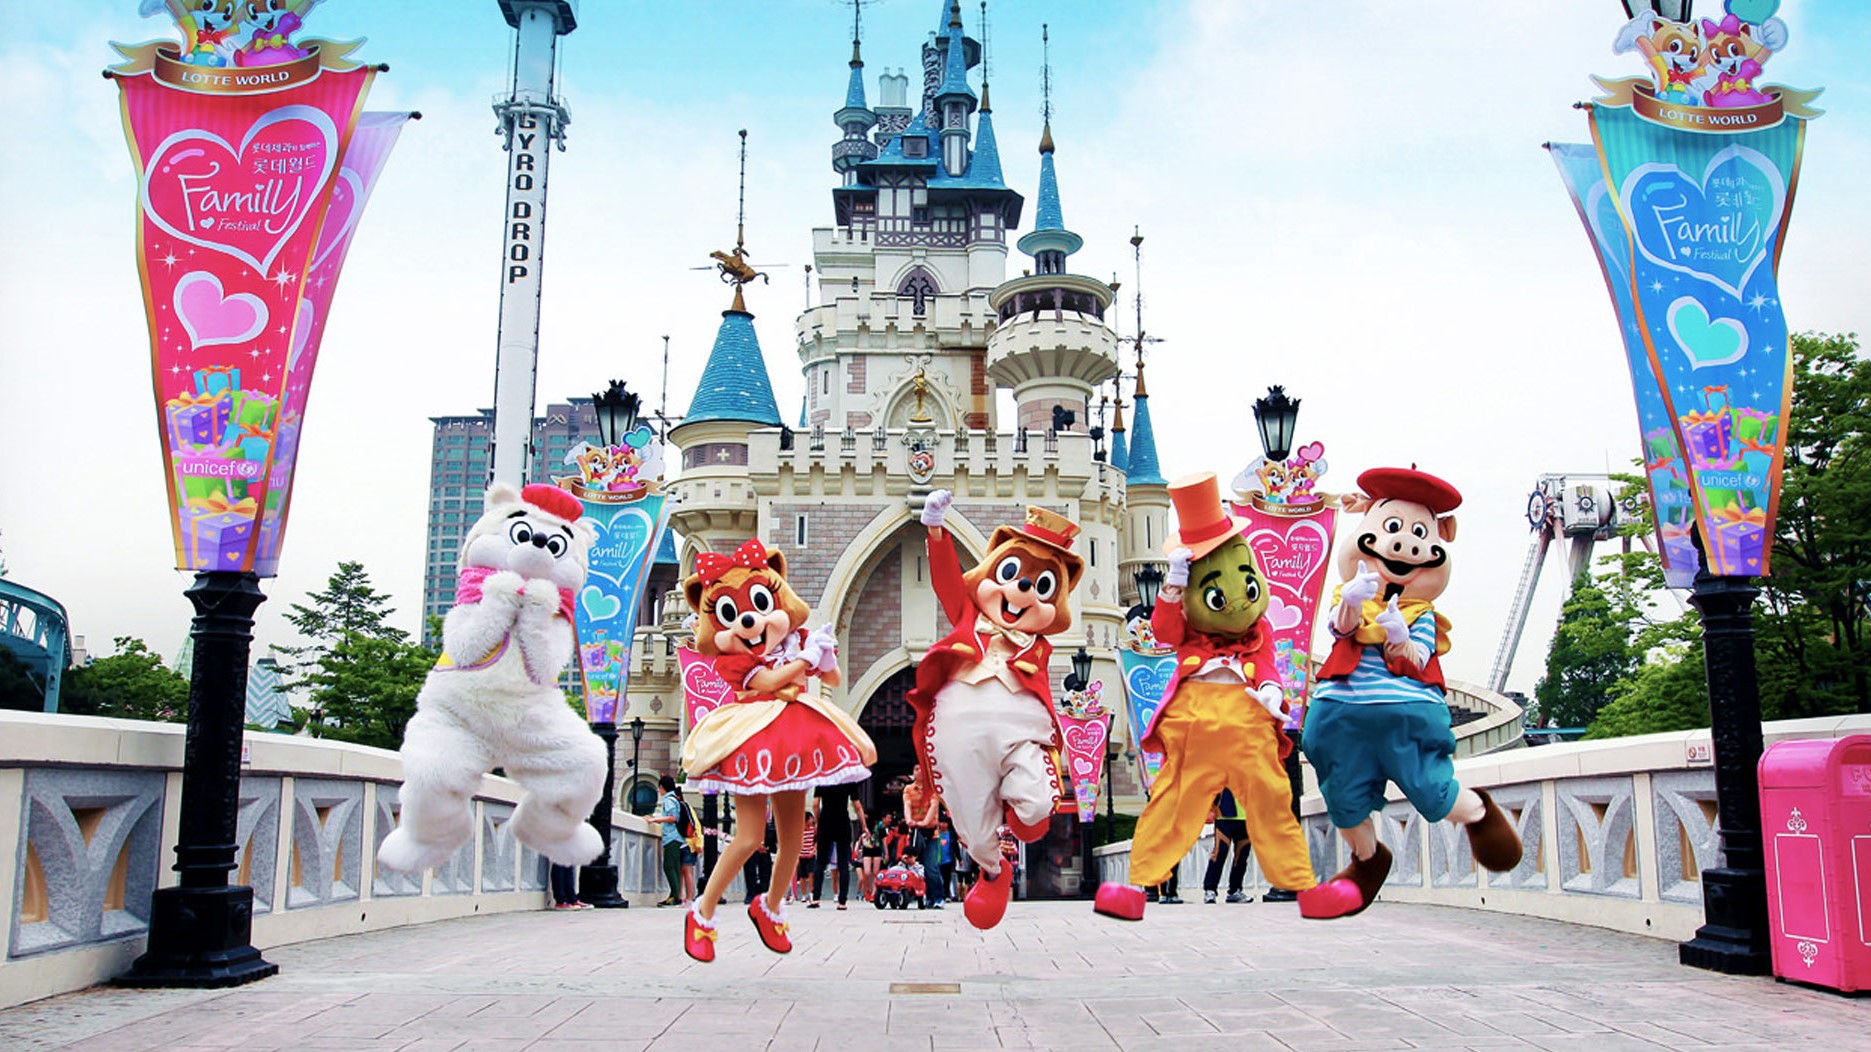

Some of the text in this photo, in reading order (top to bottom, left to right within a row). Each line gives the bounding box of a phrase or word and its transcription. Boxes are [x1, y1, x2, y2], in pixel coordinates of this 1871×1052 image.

[182, 71, 290, 85] LOTTE WORLD
[1659, 108, 1757, 125] LOTTE WORLD
[514, 112, 536, 190] GYRO
[254, 155, 317, 174] 롯데월드
[177, 161, 302, 234] Family
[217, 218, 262, 232] Festival
[1652, 193, 1760, 263] Family
[509, 201, 531, 284] DROP
[1693, 247, 1731, 260] Festival
[182, 460, 236, 475] unicef
[1702, 474, 1742, 487] unicef
[1260, 544, 1311, 579] Family
